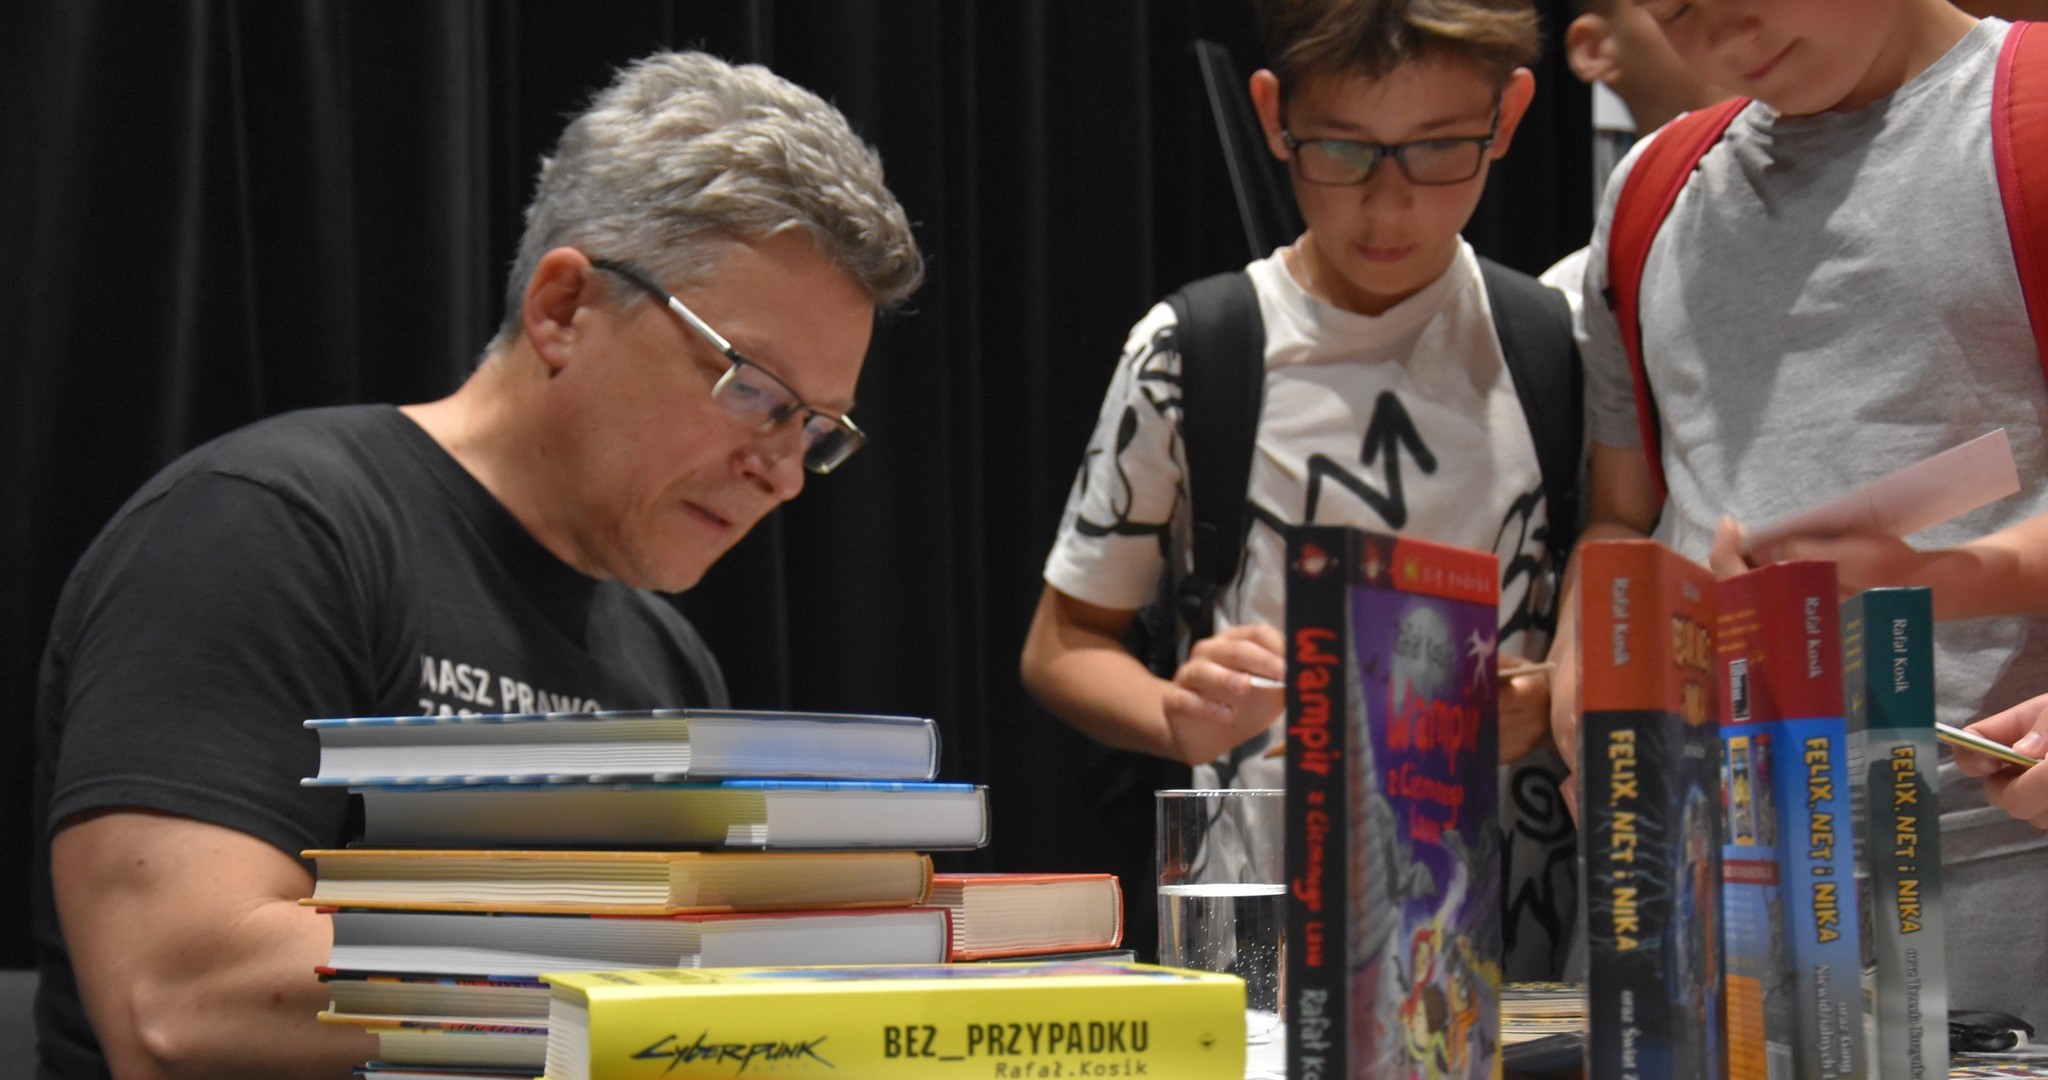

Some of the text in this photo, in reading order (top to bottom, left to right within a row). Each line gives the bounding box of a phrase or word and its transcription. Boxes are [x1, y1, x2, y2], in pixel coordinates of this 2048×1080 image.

[1288, 627, 1341, 776] Wampir
[1387, 676, 1481, 776] Wampir
[1893, 657, 1910, 693] Kosik
[1608, 729, 1640, 951] FELIX, NET i NIKA
[1804, 735, 1840, 944] FELIX, NET i NIKA
[1891, 745, 1922, 935] FELIX, NET i NIKA
[884, 1020, 1149, 1061] BEZ_PRZYPADKU
